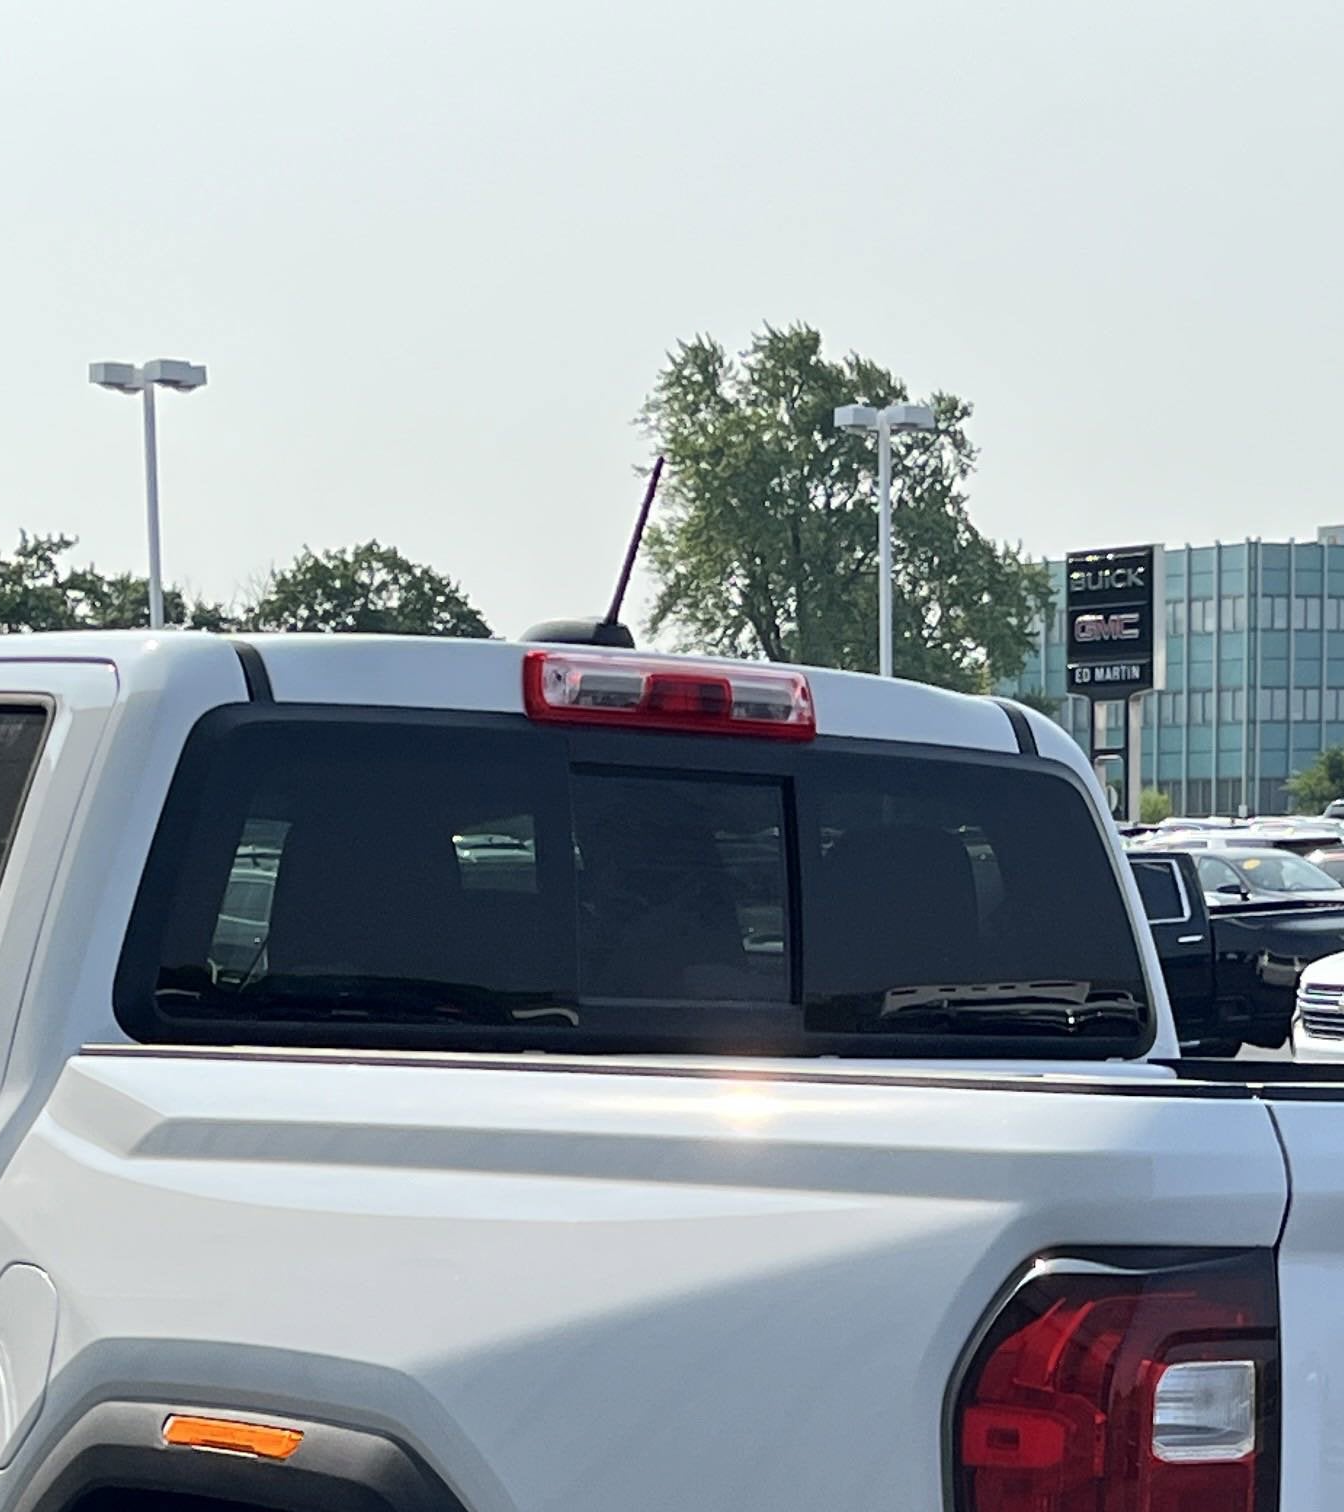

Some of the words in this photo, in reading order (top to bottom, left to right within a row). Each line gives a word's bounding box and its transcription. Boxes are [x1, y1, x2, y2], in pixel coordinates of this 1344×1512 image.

[1069, 566, 1145, 593] BUICK
[1074, 612, 1140, 643] GMC
[1074, 667, 1092, 684] ED
[1094, 664, 1141, 682] MARTIN
